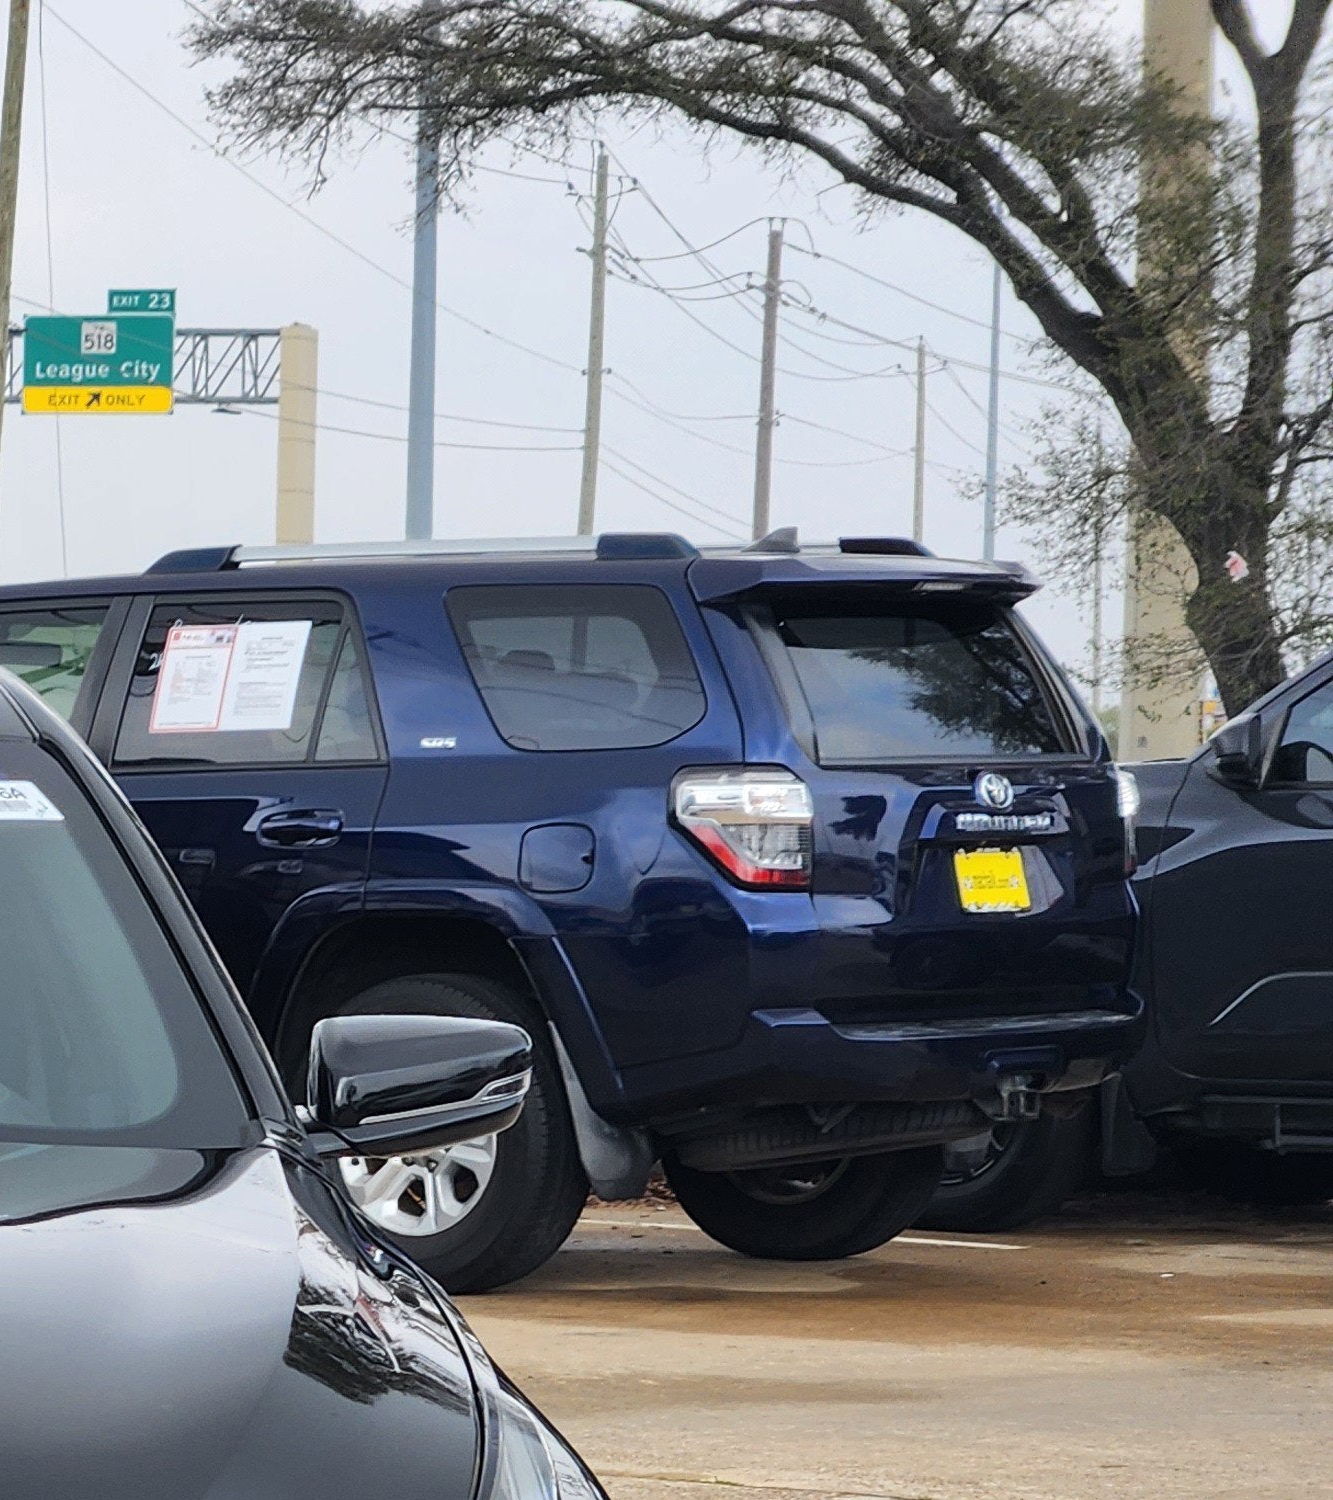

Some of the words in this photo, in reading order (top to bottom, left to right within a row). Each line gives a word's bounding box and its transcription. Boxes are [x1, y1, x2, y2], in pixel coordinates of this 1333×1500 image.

[112, 296, 139, 307] EXIT
[148, 293, 171, 309] 23
[84, 333, 114, 351] 518
[35, 361, 110, 383] League
[120, 359, 161, 384] City
[47, 394, 79, 406] EXIT
[105, 394, 146, 406] ONLY
